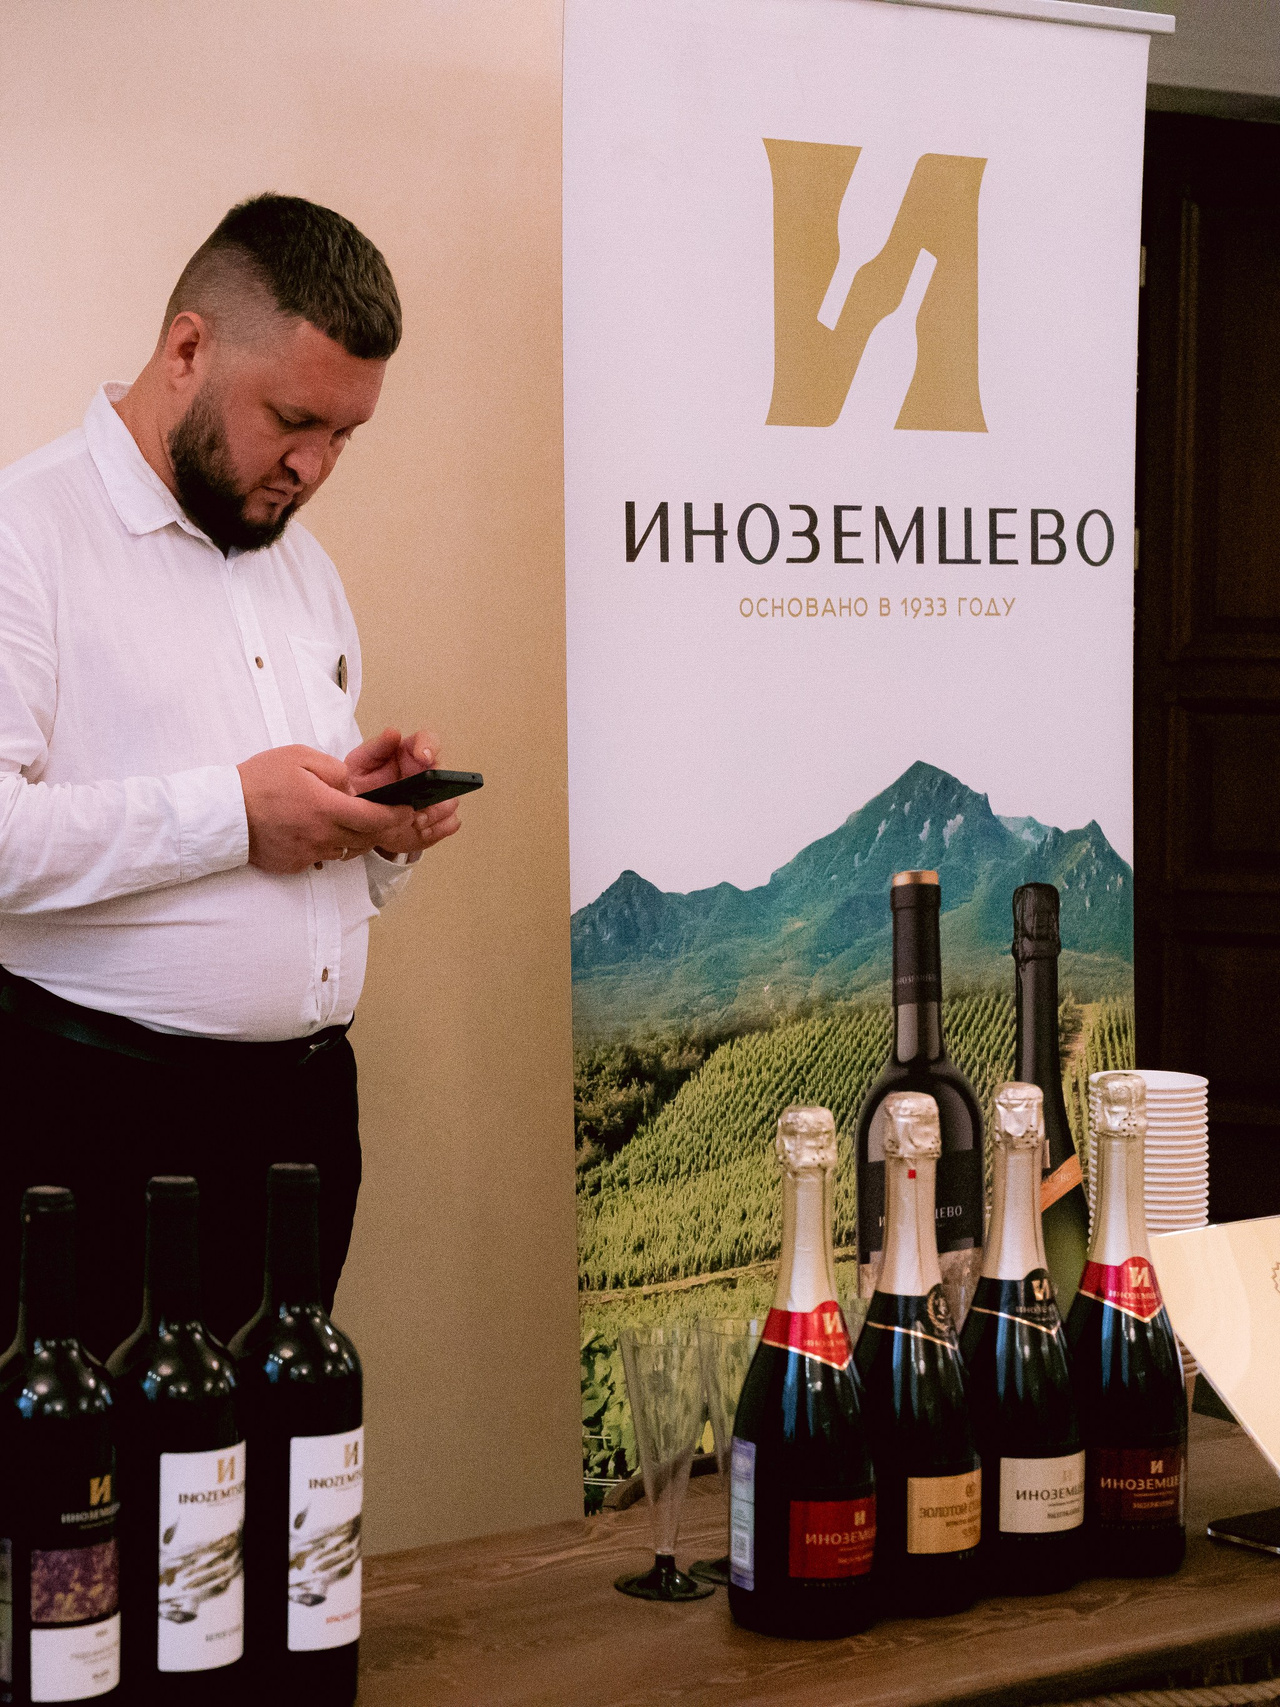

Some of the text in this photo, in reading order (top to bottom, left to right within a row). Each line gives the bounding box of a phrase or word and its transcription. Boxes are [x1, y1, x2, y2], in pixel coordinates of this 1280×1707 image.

[624, 500, 1115, 567] ИНОЗЕМЦЕВО
[739, 597, 1016, 620] ОСНОВАНО В 1933 ГОДУ
